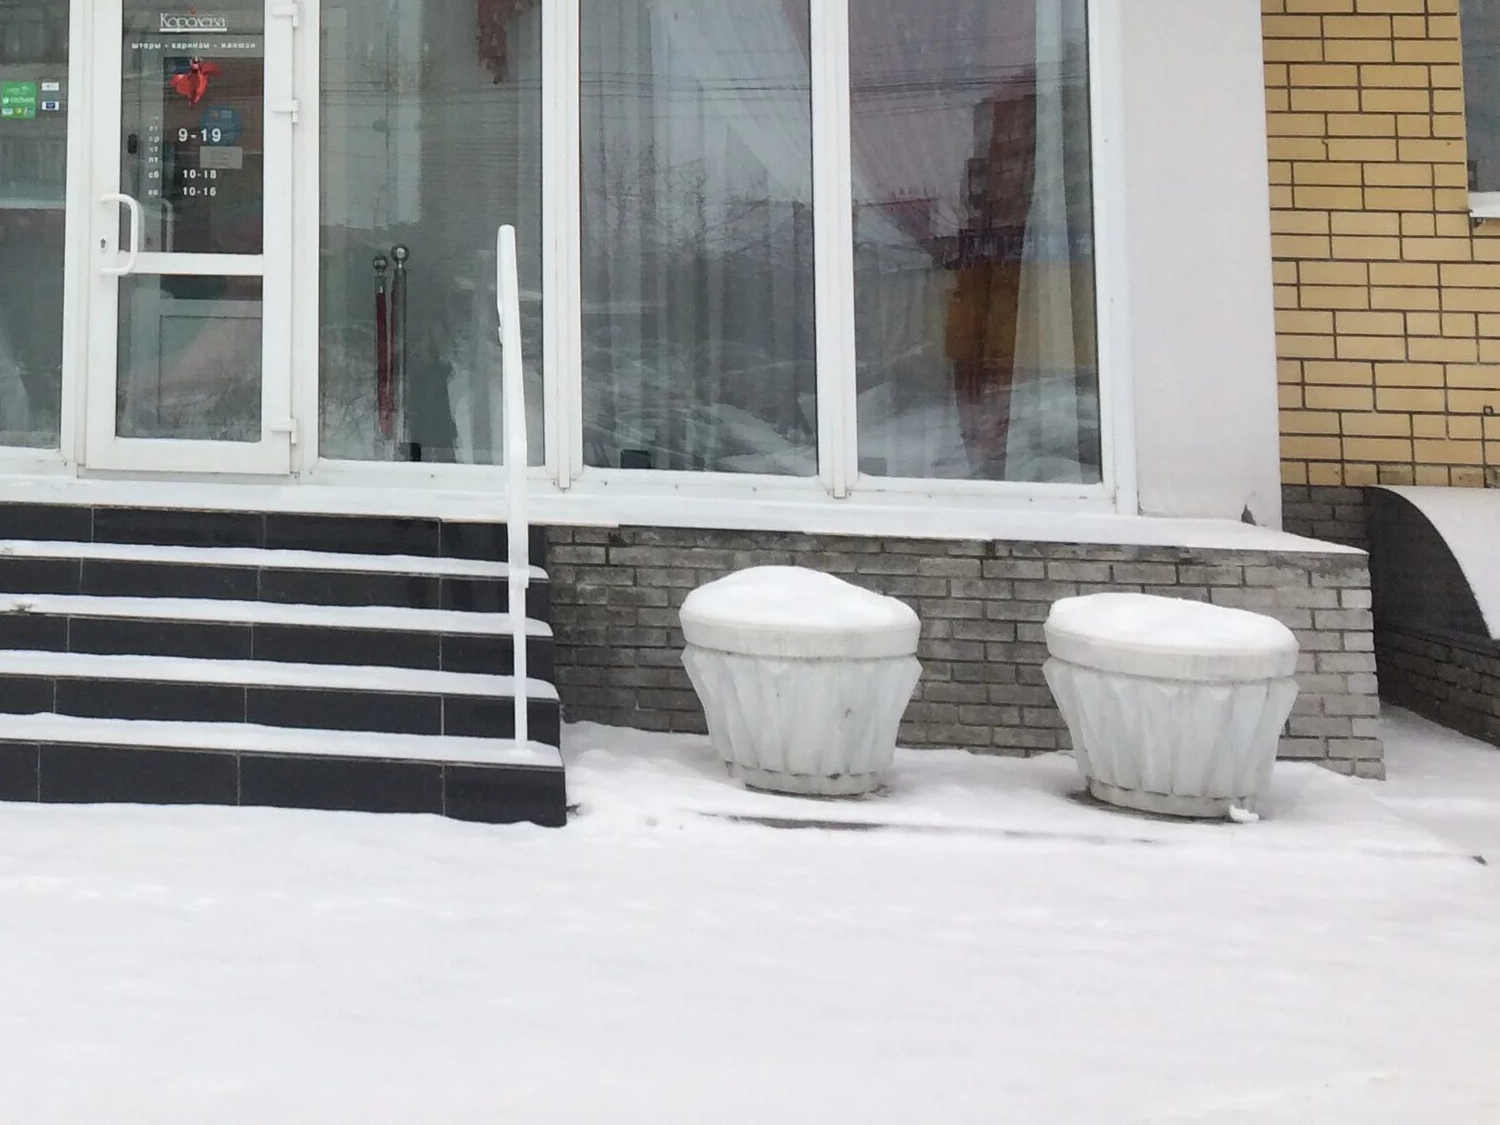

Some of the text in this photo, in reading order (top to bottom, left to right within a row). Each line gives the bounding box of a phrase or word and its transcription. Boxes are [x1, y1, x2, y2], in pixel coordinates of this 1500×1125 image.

[178, 128, 221, 142] 9-19
[183, 169, 217, 179] 10-18
[183, 187, 217, 196] 10-16
